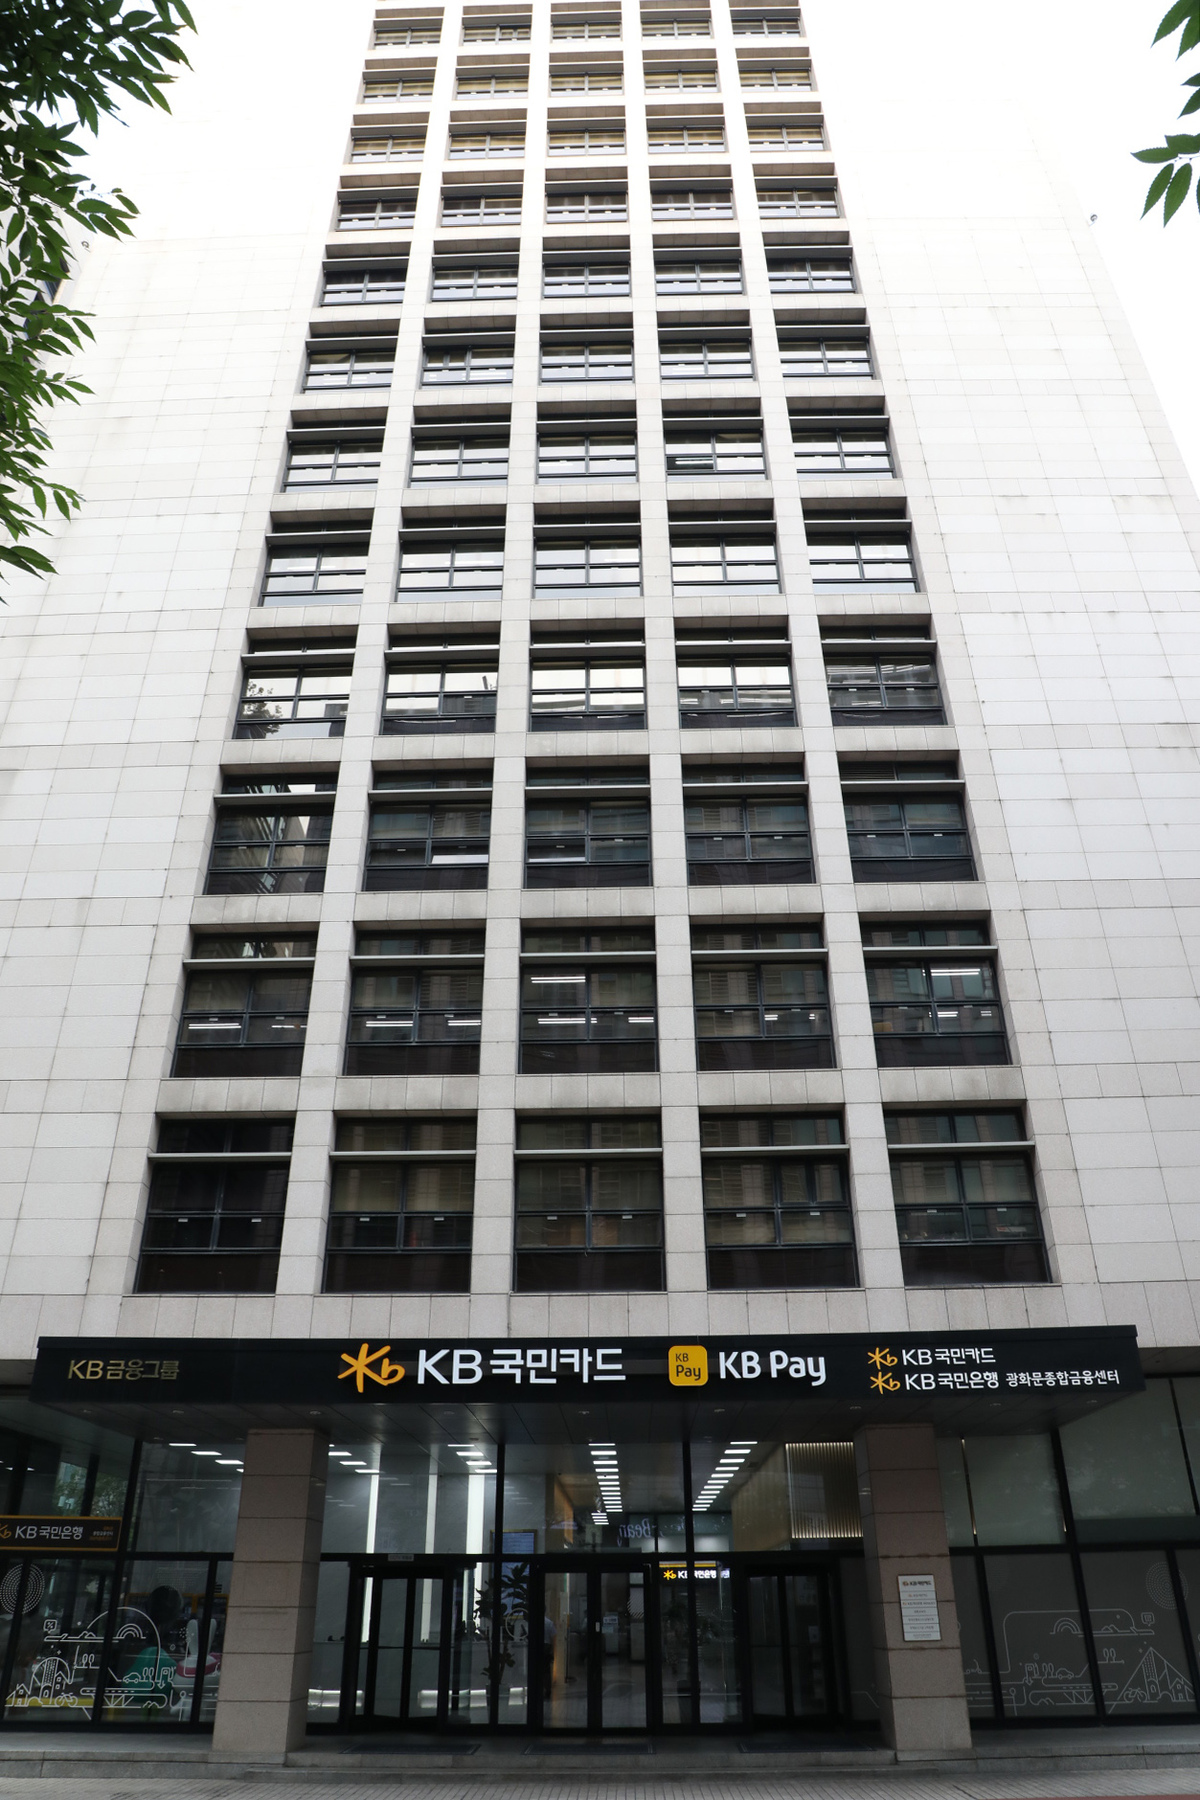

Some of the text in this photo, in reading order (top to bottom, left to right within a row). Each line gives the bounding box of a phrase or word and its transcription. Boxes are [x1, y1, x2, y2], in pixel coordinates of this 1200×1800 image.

[675, 1352, 690, 1362] KB
[675, 1364, 702, 1381] Pay
[718, 1349, 827, 1387] KB Pay
[1005, 1369, 1120, 1388] 광화문종합금융센터
